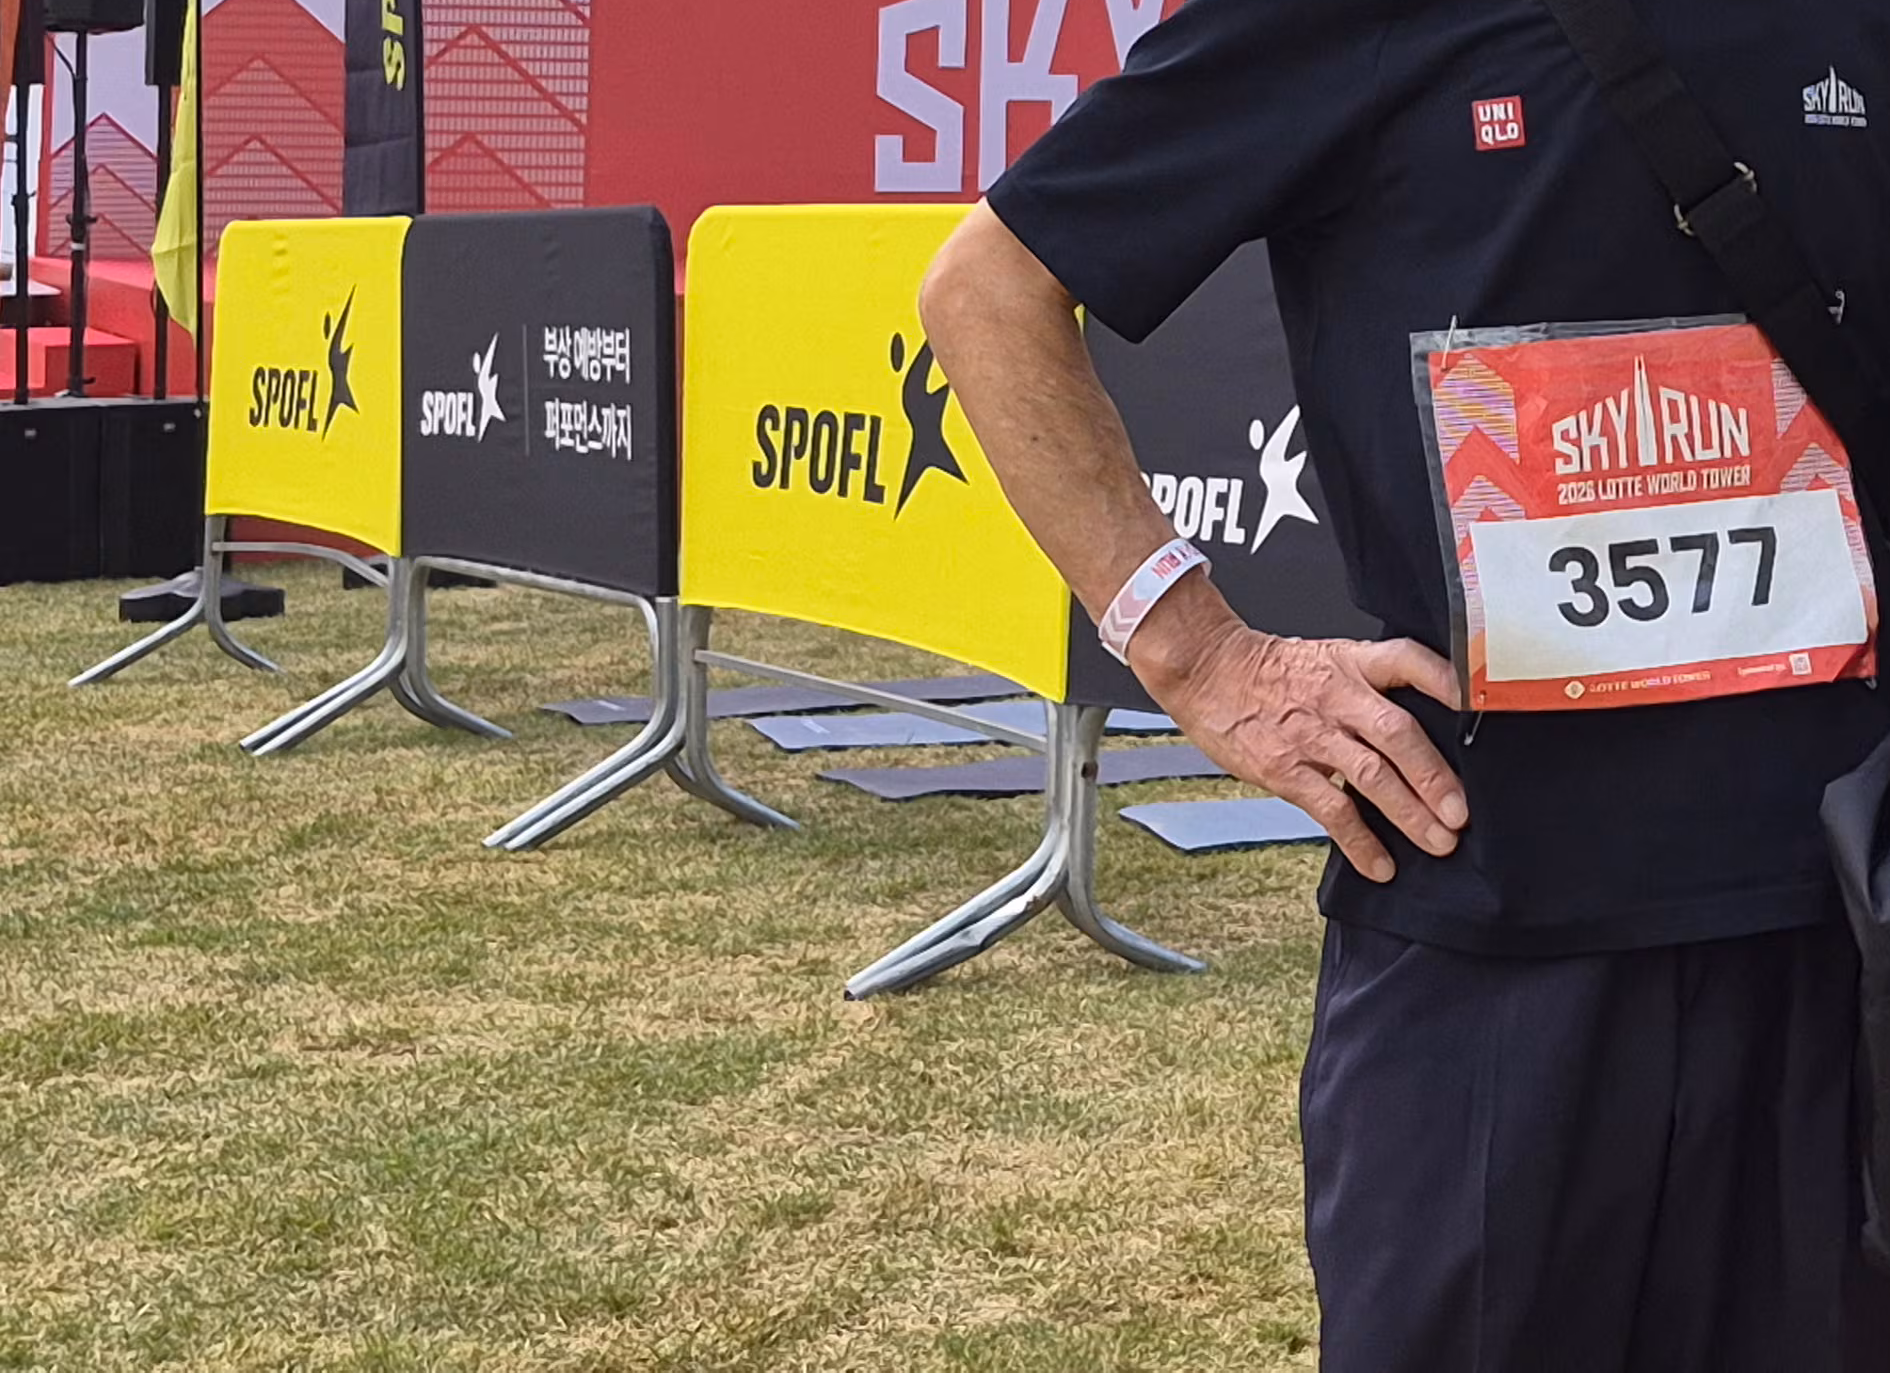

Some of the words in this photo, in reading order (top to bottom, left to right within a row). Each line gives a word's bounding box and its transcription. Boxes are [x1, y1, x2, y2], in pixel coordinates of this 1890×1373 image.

[1478, 101, 1514, 122] UNI
[1802, 77, 1830, 113] SKY
[1838, 79, 1866, 115] RUN
[1481, 122, 1519, 146] QLO
[543, 324, 572, 380] 부상
[573, 326, 631, 385] 예방부터
[249, 365, 318, 433] SPOFL
[420, 390, 476, 437] SPOFL
[544, 397, 632, 461] 퍼포먼스까지
[751, 404, 886, 505] SPOFL
[1552, 387, 1630, 476] SKY
[1658, 385, 1751, 465] RUN
[1141, 472, 1246, 545] POFL
[1598, 474, 1644, 501] LOTTE
[1646, 469, 1697, 497] WORLD
[1700, 463, 1751, 490] TOWER
[1548, 526, 1778, 628] 3577
